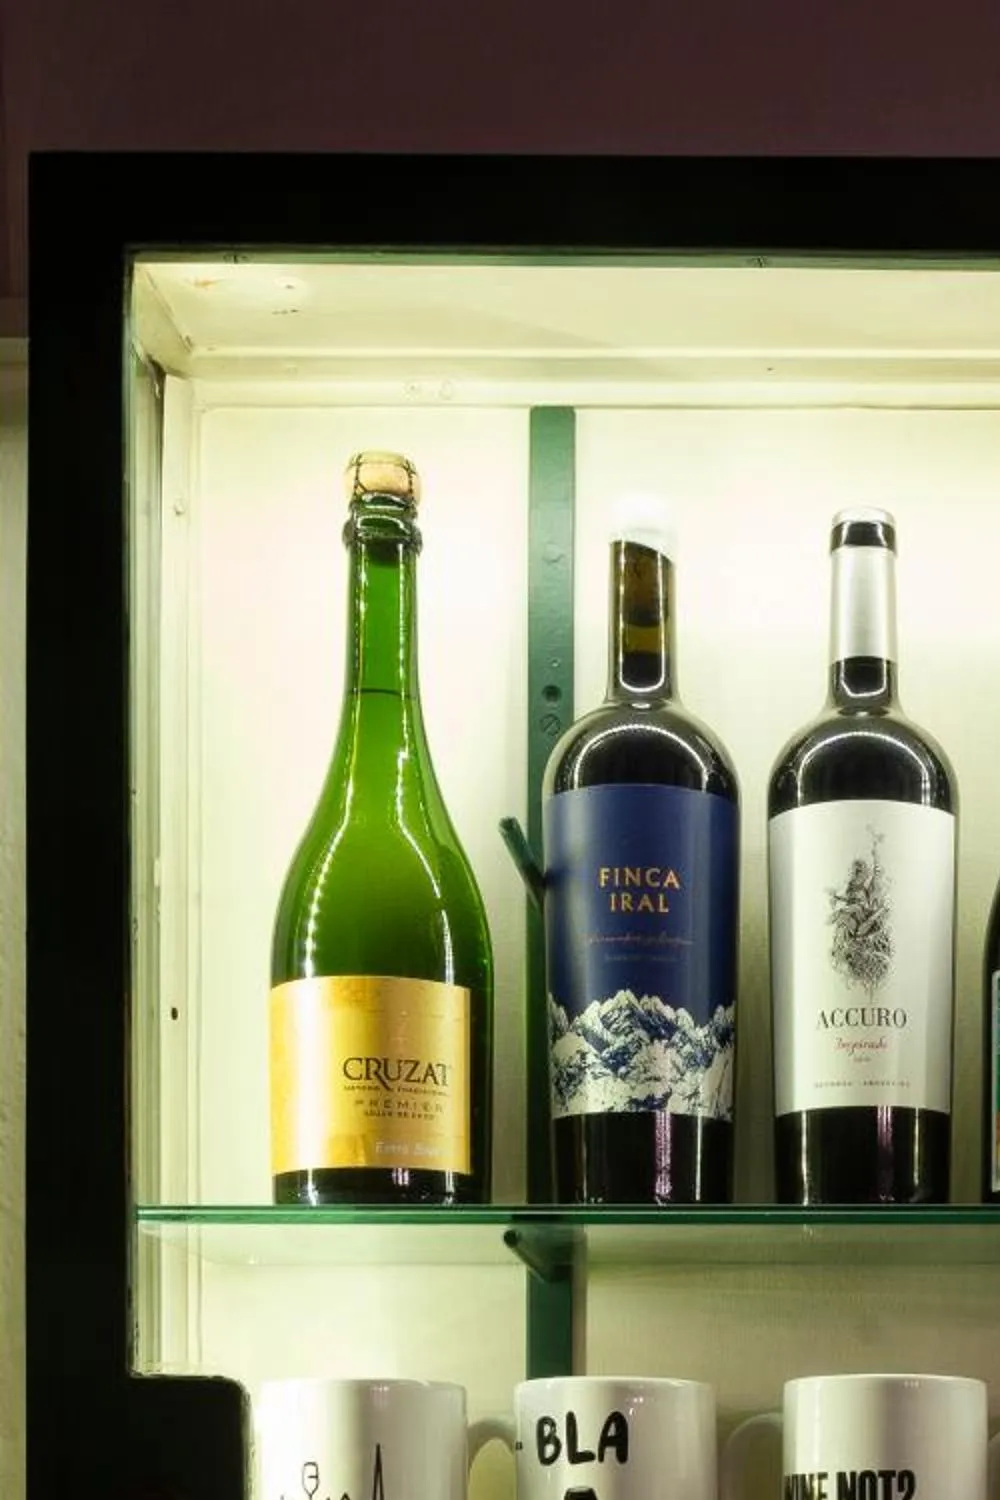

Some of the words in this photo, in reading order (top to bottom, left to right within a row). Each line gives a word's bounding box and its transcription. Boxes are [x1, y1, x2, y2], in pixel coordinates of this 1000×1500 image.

[599, 867, 681, 889] FINCA
[609, 893, 670, 913] IRAL
[816, 1007, 908, 1029] ACCURO
[342, 1057, 449, 1092] CRUZAT
[536, 1411, 629, 1466] BLA
